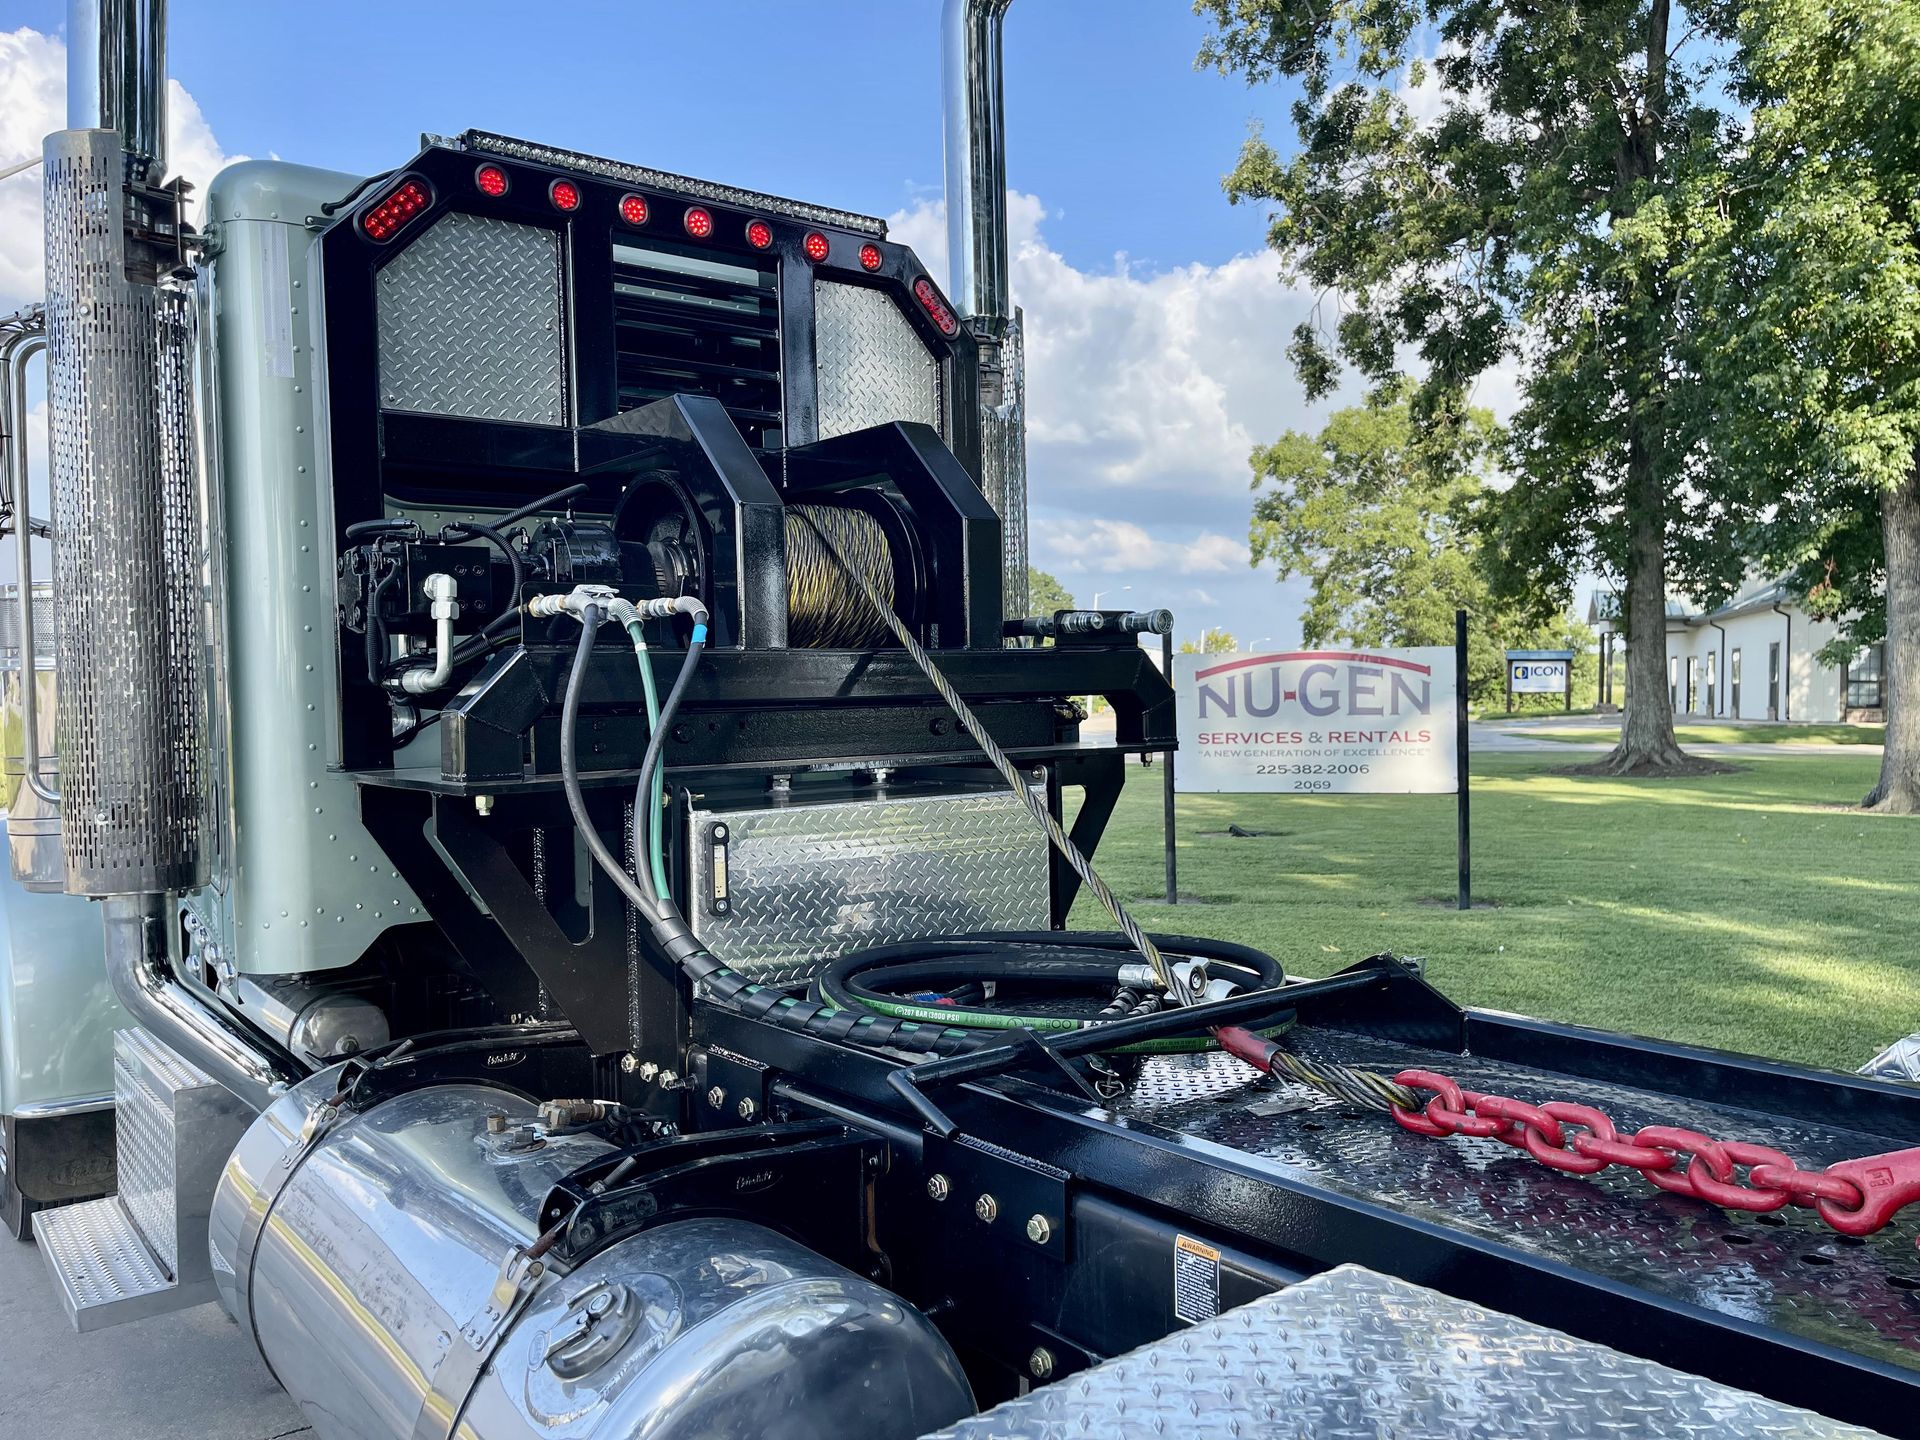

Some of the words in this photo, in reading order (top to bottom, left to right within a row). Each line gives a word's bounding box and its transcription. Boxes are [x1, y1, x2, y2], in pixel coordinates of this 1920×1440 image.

[1530, 665, 1564, 676] ICON
[1198, 663, 1431, 719] NU-GEN
[1198, 731, 1303, 745] SERVICES
[1308, 731, 1323, 744] &
[1328, 730, 1431, 744] RENTALS
[1214, 749, 1241, 757] NEW
[1243, 748, 1321, 758] GENERATION
[1324, 748, 1340, 757] OF
[1256, 763, 1370, 775] 225-382-2006
[1294, 780, 1331, 790] 2069
[915, 1010, 928, 1018] BAR
[1187, 1243, 1214, 1258] WARNING
